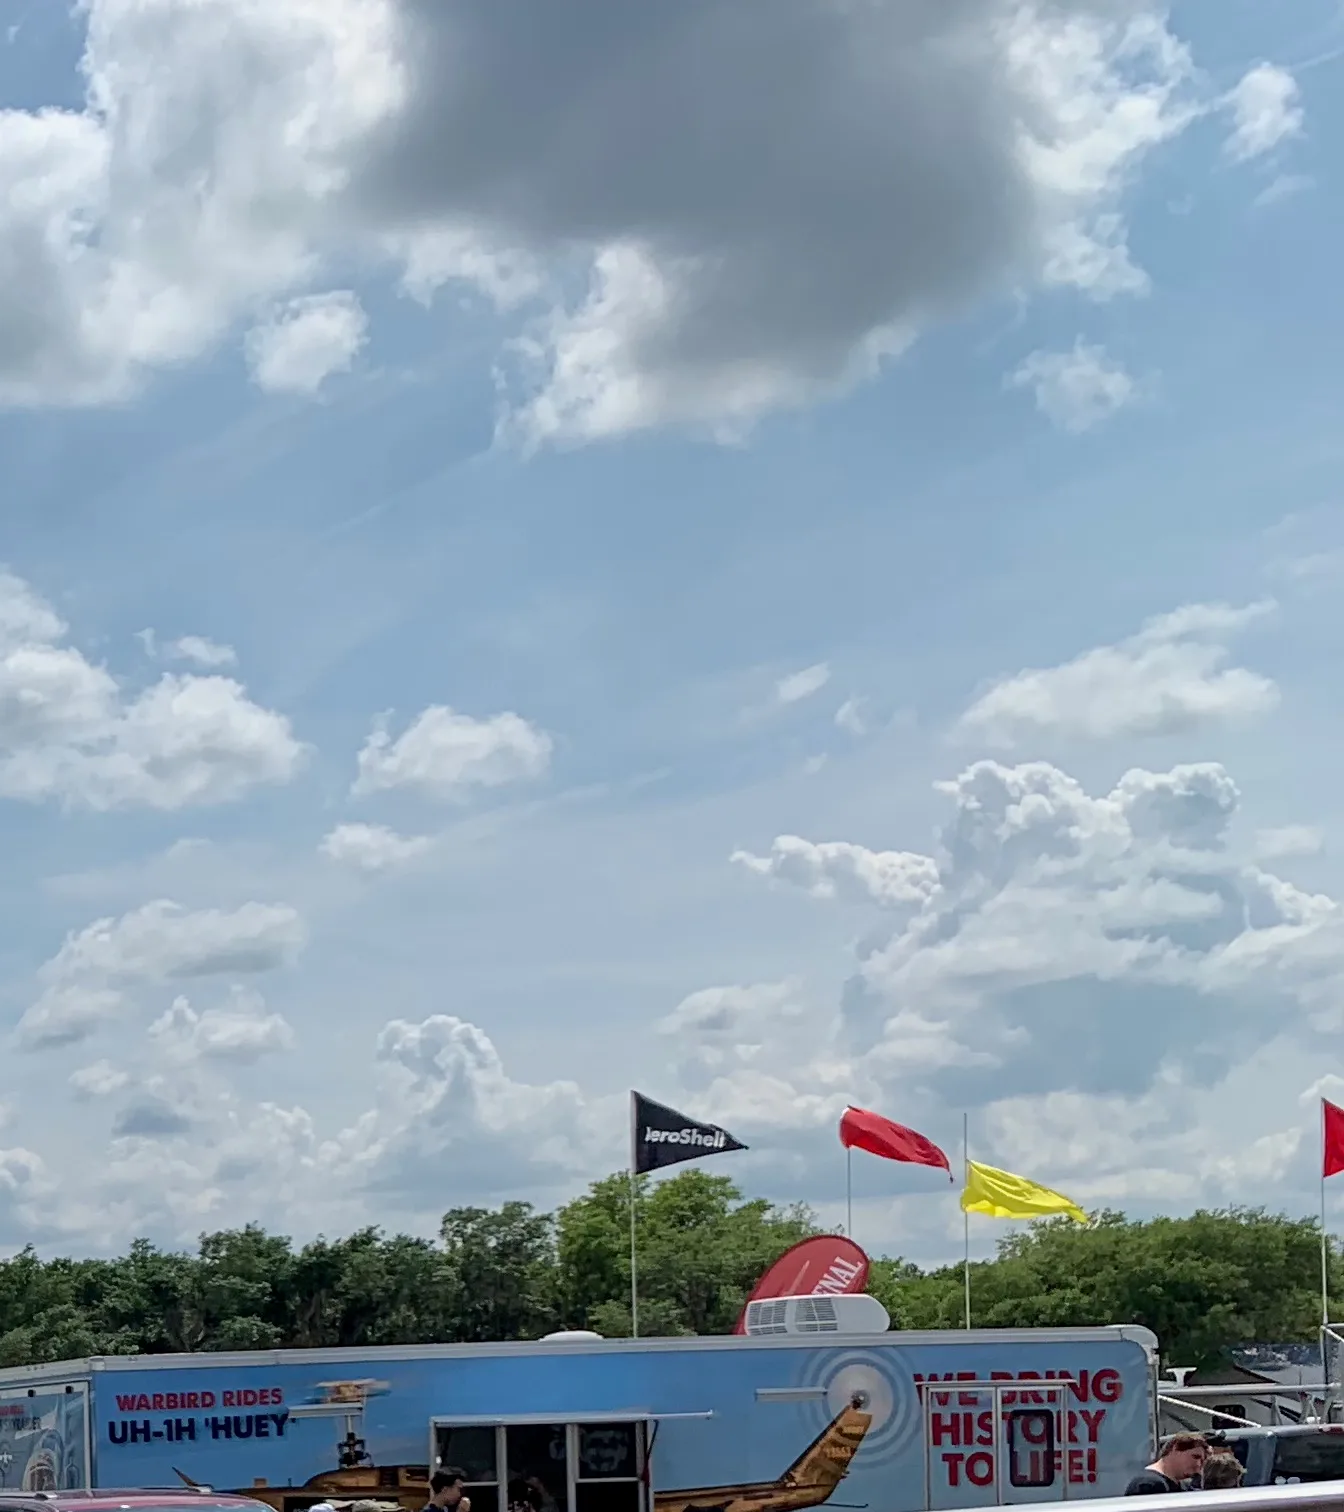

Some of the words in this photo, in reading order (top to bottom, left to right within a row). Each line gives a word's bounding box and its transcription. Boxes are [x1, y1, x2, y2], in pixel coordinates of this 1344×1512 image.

[116, 1389, 216, 1412] WARBIRD
[222, 1387, 283, 1407] RIDES
[913, 1371, 978, 1406] WE
[990, 1368, 1123, 1404] BRING
[108, 1418, 196, 1444] UH-1H
[931, 1408, 1107, 1446] HISTORY
[942, 1451, 994, 1487] TO
[1012, 1447, 1098, 1488] LIFE!
